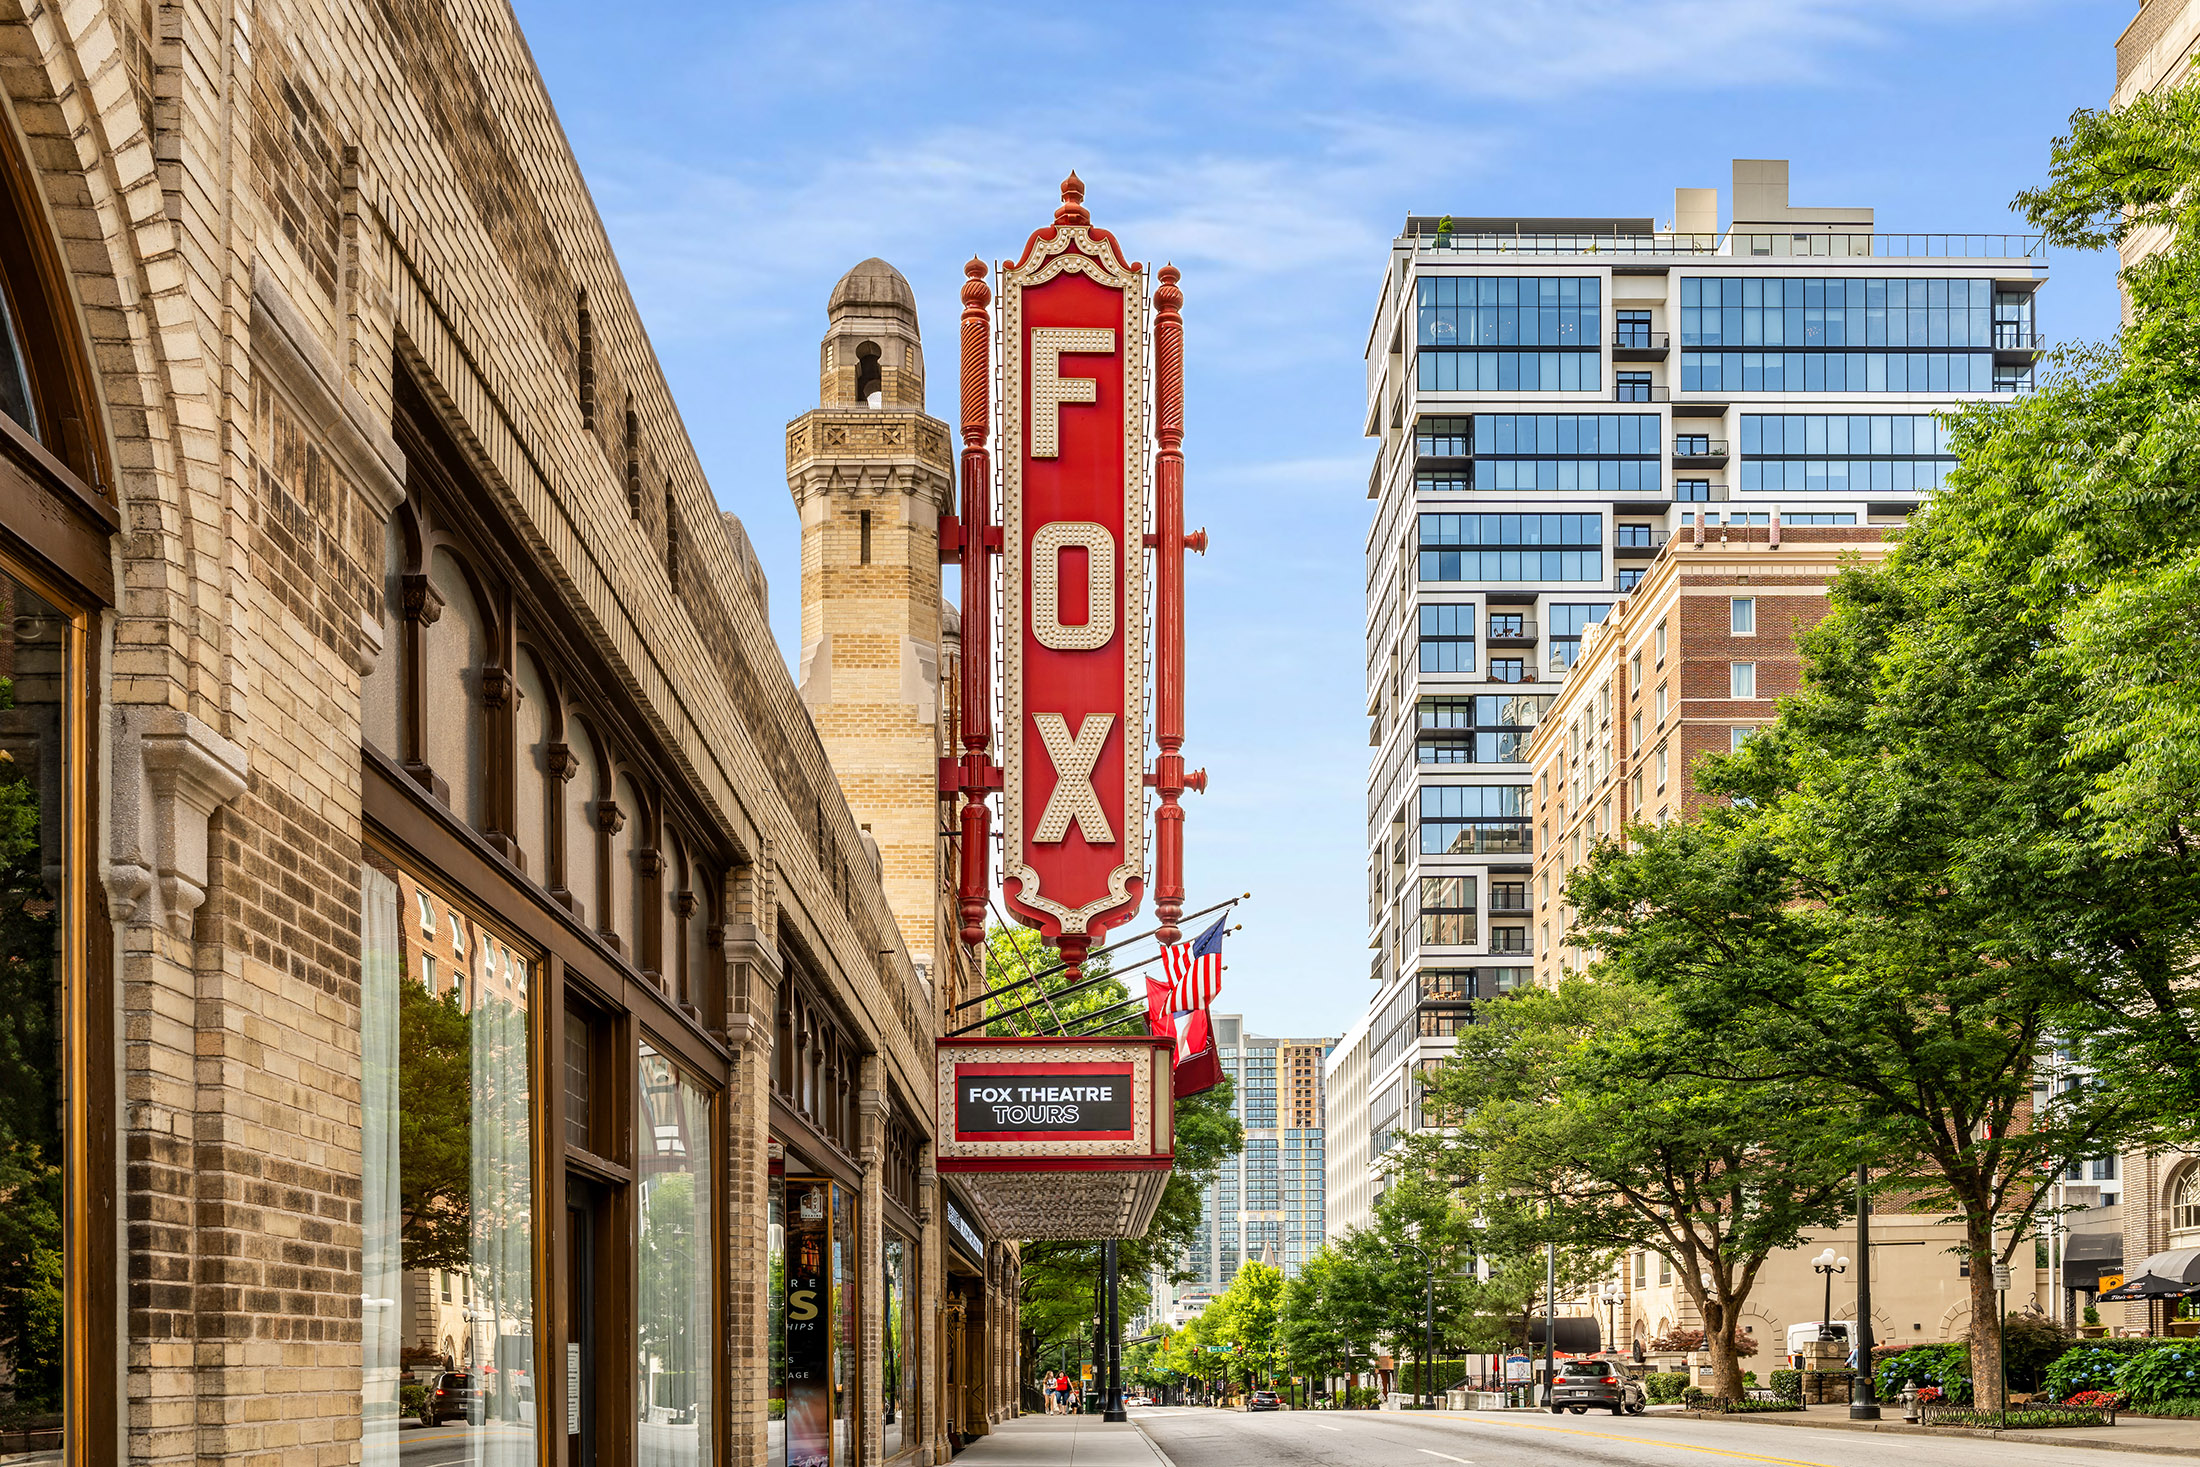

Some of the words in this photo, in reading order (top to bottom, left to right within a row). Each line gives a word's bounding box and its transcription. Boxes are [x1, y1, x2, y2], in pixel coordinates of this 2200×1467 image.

[1030, 326, 1116, 844] FOX
[969, 1087, 1013, 1103] FOX
[1018, 1086, 1113, 1102] THEATRE
[992, 1105, 1080, 1124] TOURS
[788, 1290, 818, 1321] S
